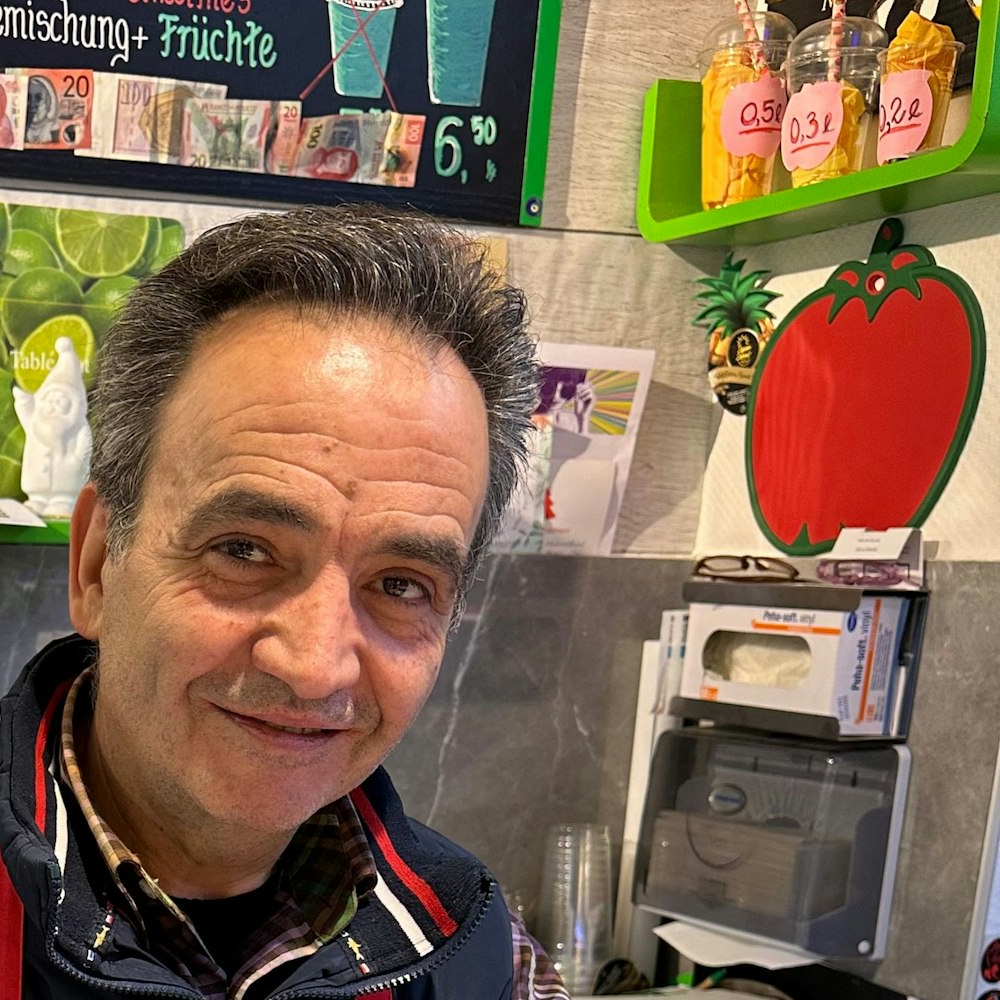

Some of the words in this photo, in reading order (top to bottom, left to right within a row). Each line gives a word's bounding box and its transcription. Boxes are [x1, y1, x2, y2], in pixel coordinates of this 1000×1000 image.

[158, 13, 277, 68] Früchte
[63, 75, 89, 98] 20
[283, 106, 297, 118] 20
